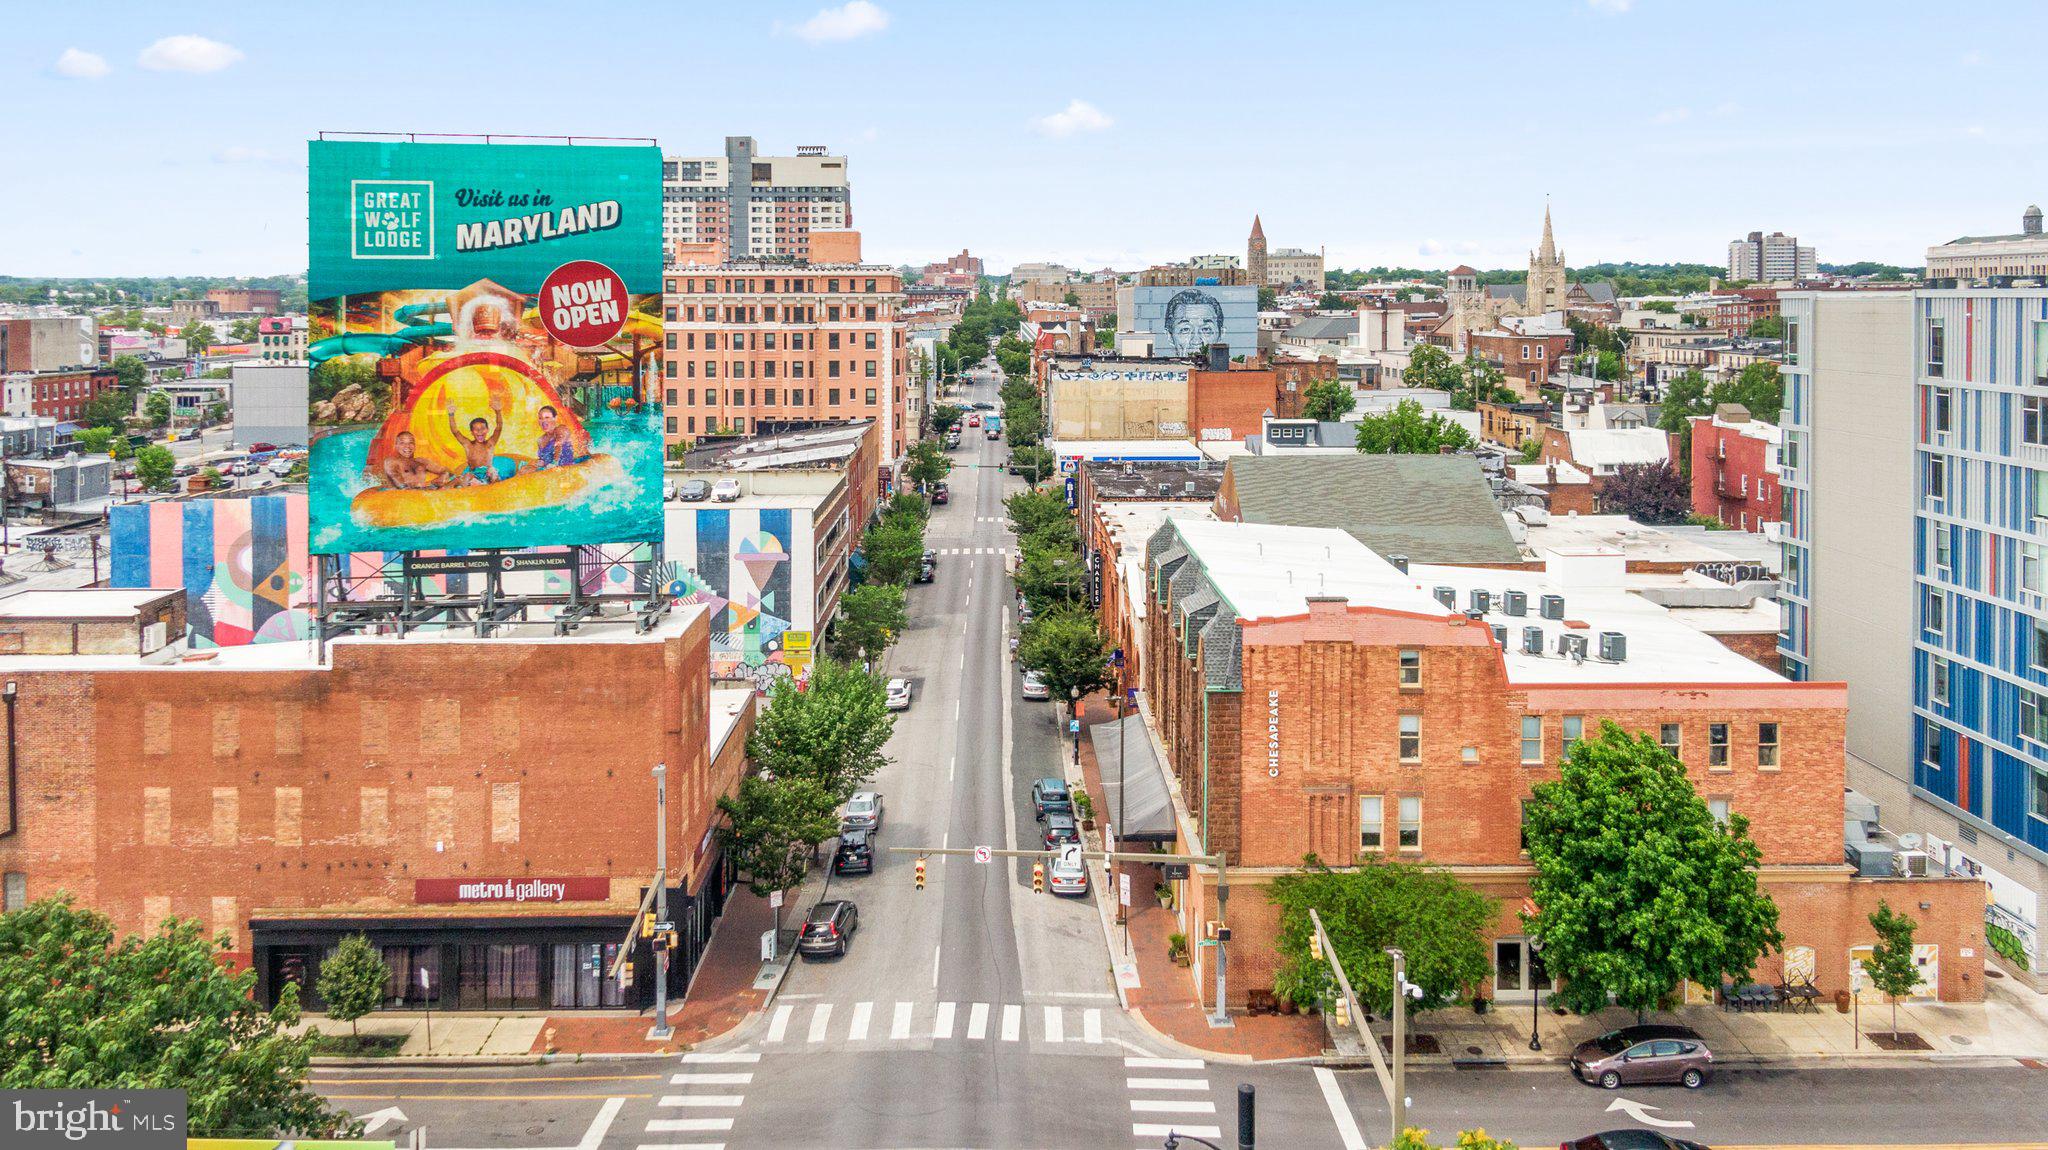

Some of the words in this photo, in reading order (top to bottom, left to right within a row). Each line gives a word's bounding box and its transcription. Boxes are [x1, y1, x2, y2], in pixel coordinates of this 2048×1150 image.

[364, 191, 422, 209] GREAT
[455, 188, 505, 207] Visit
[507, 194, 530, 207] us
[531, 189, 554, 207] in
[455, 200, 622, 252] MARYLAND
[364, 231, 422, 248] LODGE
[551, 277, 612, 309] NOW
[552, 300, 620, 332] OPEN
[546, 557, 566, 565] MEDIA
[1268, 689, 1279, 778] CHESAPEAKE
[459, 881, 504, 899] metro
[516, 879, 566, 902] gallery
